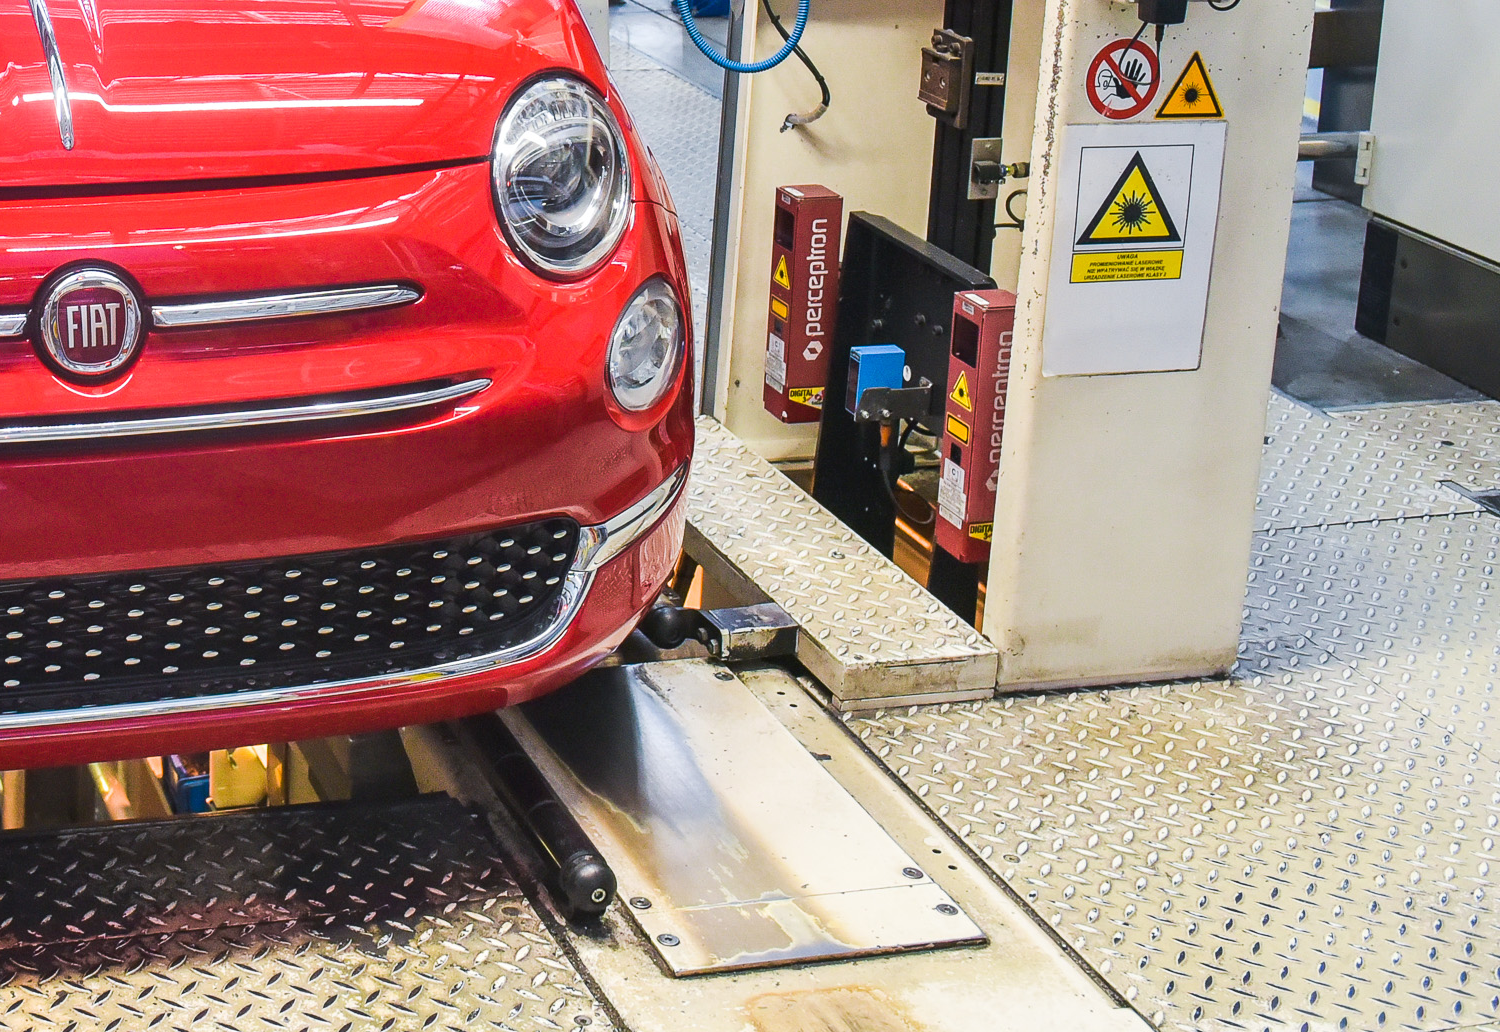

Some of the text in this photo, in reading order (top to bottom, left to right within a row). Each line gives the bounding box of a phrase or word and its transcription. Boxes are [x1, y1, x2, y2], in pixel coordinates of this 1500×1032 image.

[805, 218, 829, 337] perceptron
[66, 302, 121, 349] FIAT
[790, 389, 813, 398] DIGITAL
[969, 524, 994, 534] DIGITA
